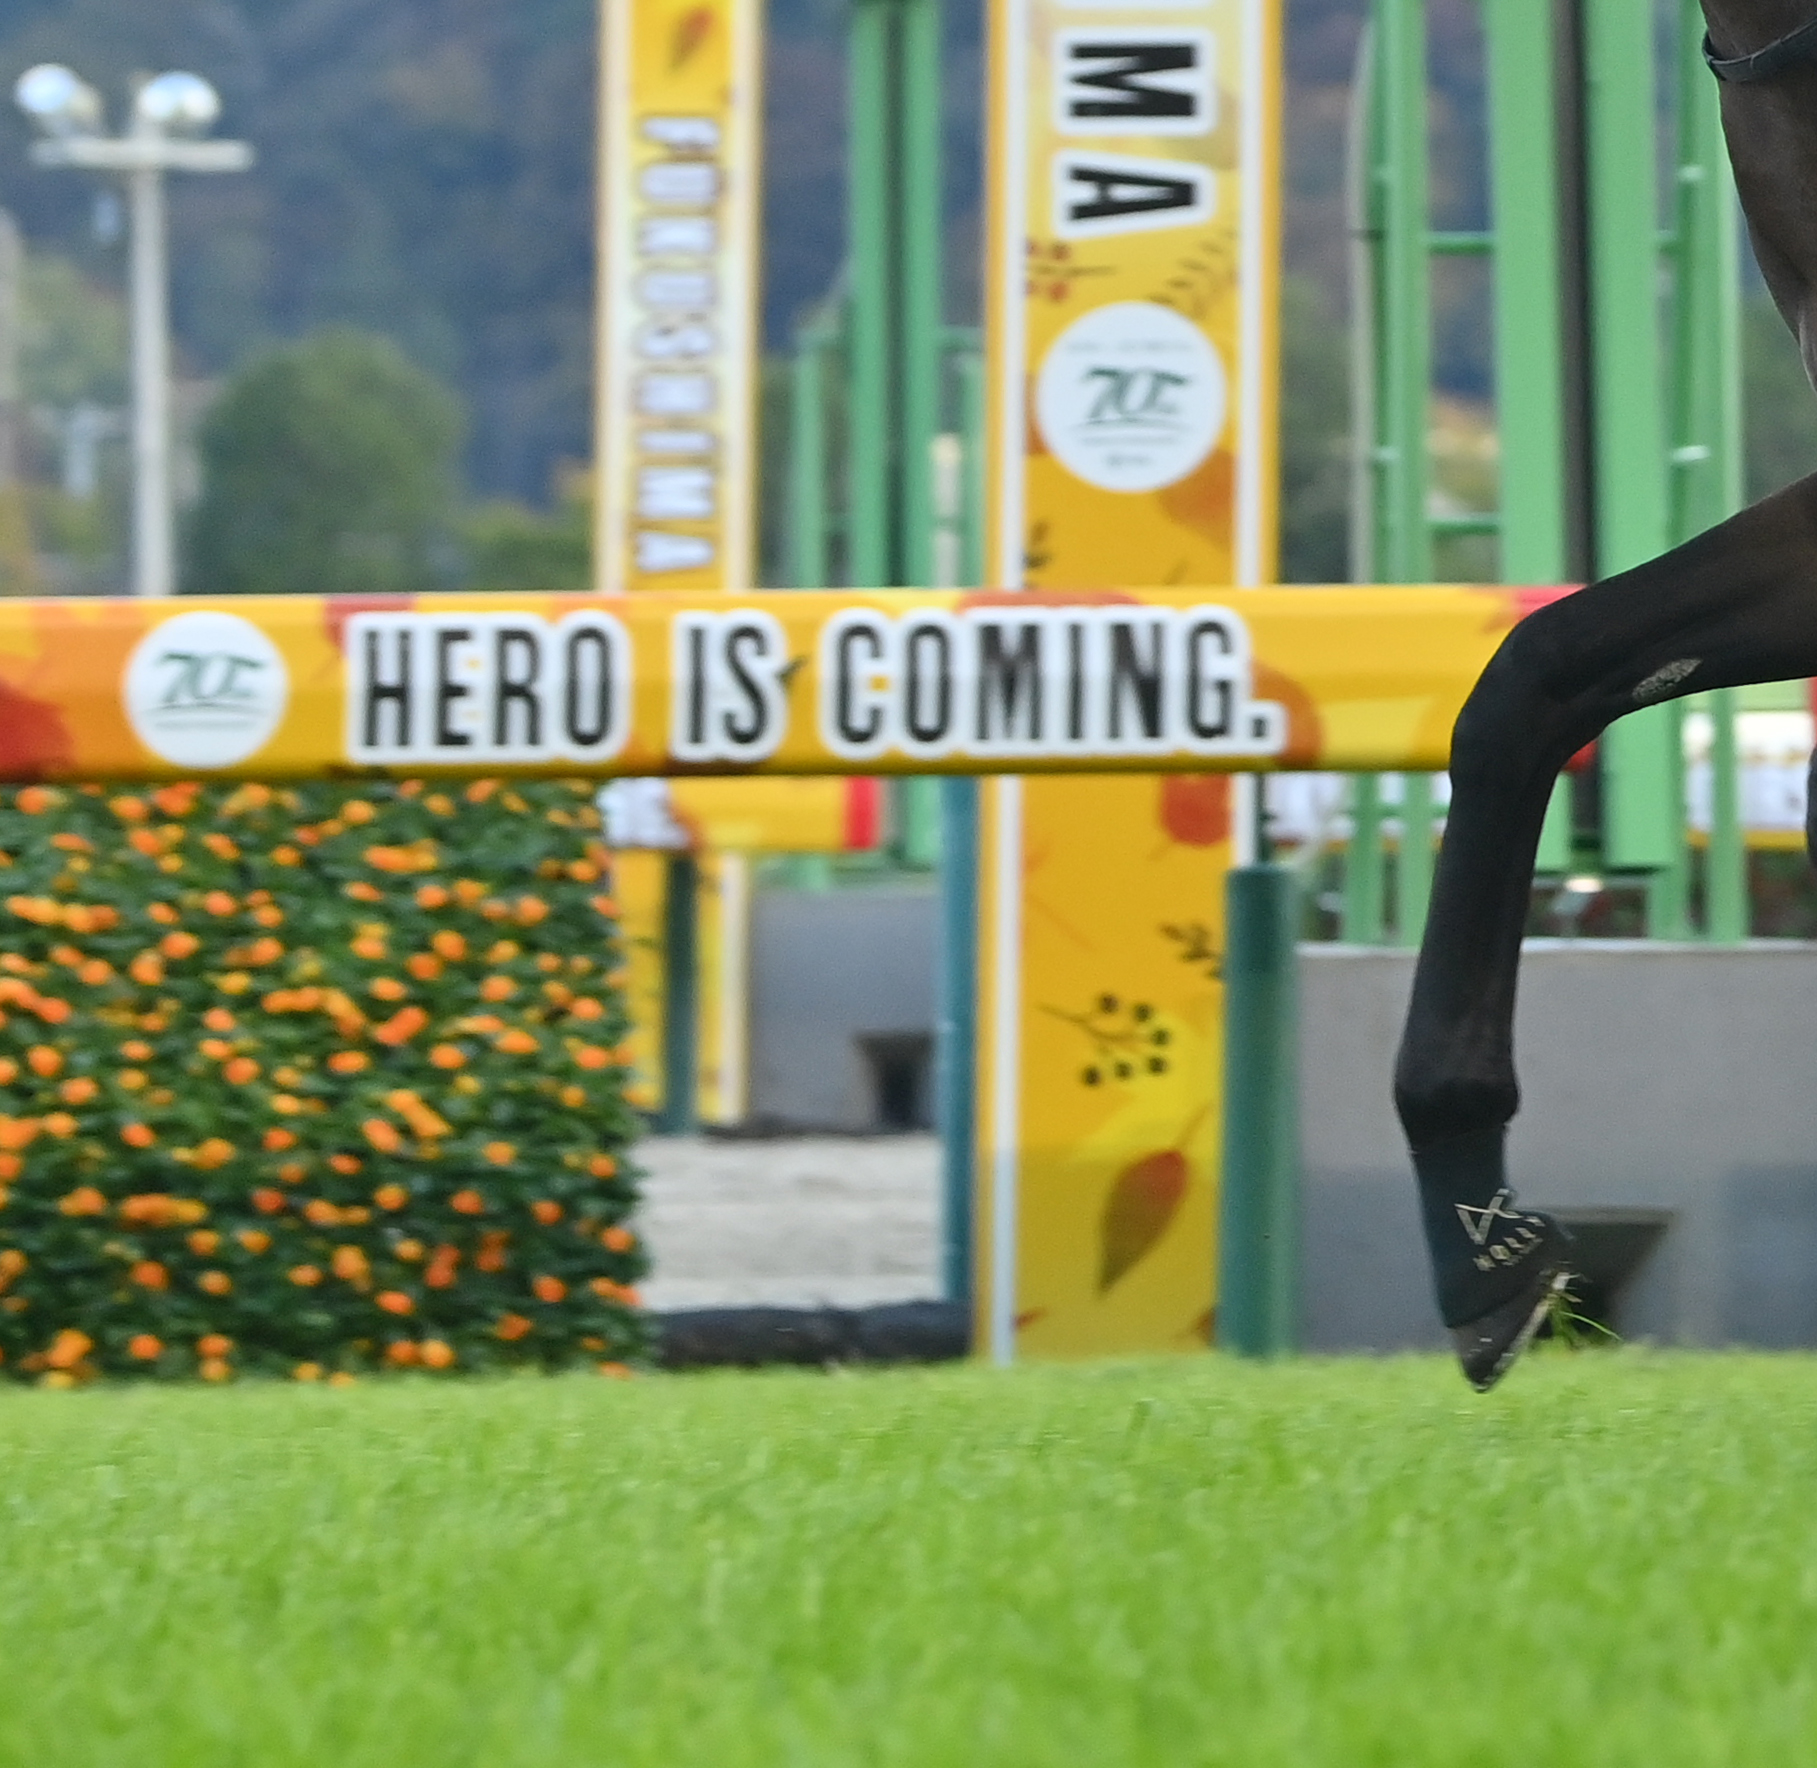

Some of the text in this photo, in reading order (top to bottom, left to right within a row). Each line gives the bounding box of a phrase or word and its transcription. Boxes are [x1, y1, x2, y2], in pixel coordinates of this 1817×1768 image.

[636, 116, 722, 572] FUKUSHIMA
[363, 620, 1268, 747] HERO IS COMING.
